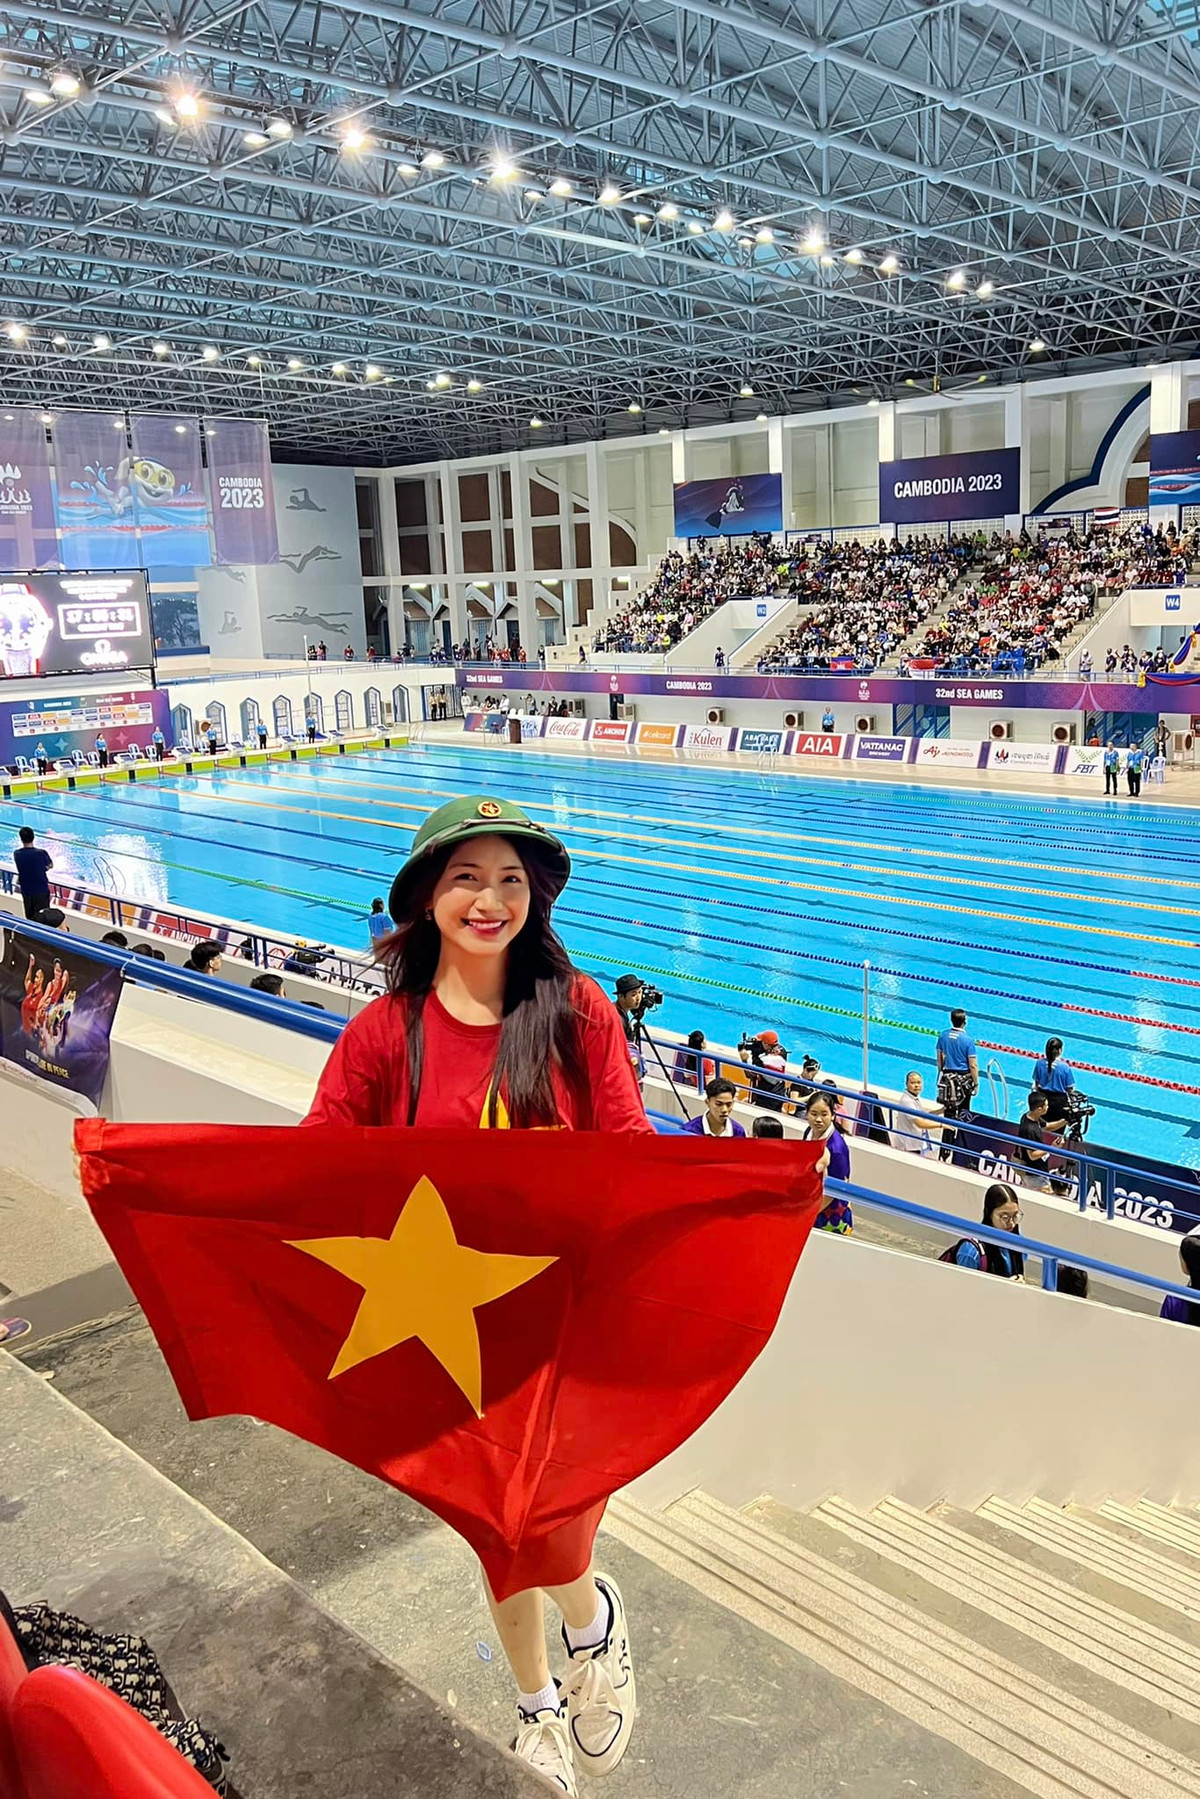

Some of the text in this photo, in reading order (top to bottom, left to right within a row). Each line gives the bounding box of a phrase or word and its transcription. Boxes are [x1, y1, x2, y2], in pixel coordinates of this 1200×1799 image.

[219, 477, 263, 488] CAMBODIA
[894, 474, 1002, 498] CAMBODIA 2023
[220, 488, 264, 508] 2023
[1166, 597, 1180, 608] W4
[666, 680, 712, 691] CAMBODIA 2023
[935, 687, 1004, 700] 32nd SEA GAMES
[693, 732, 723, 746] Kulen
[801, 736, 834, 754] AIA
[860, 741, 903, 751] VATTANAC
[1072, 764, 1098, 773] FBT
[1114, 1187, 1174, 1229] 2023
